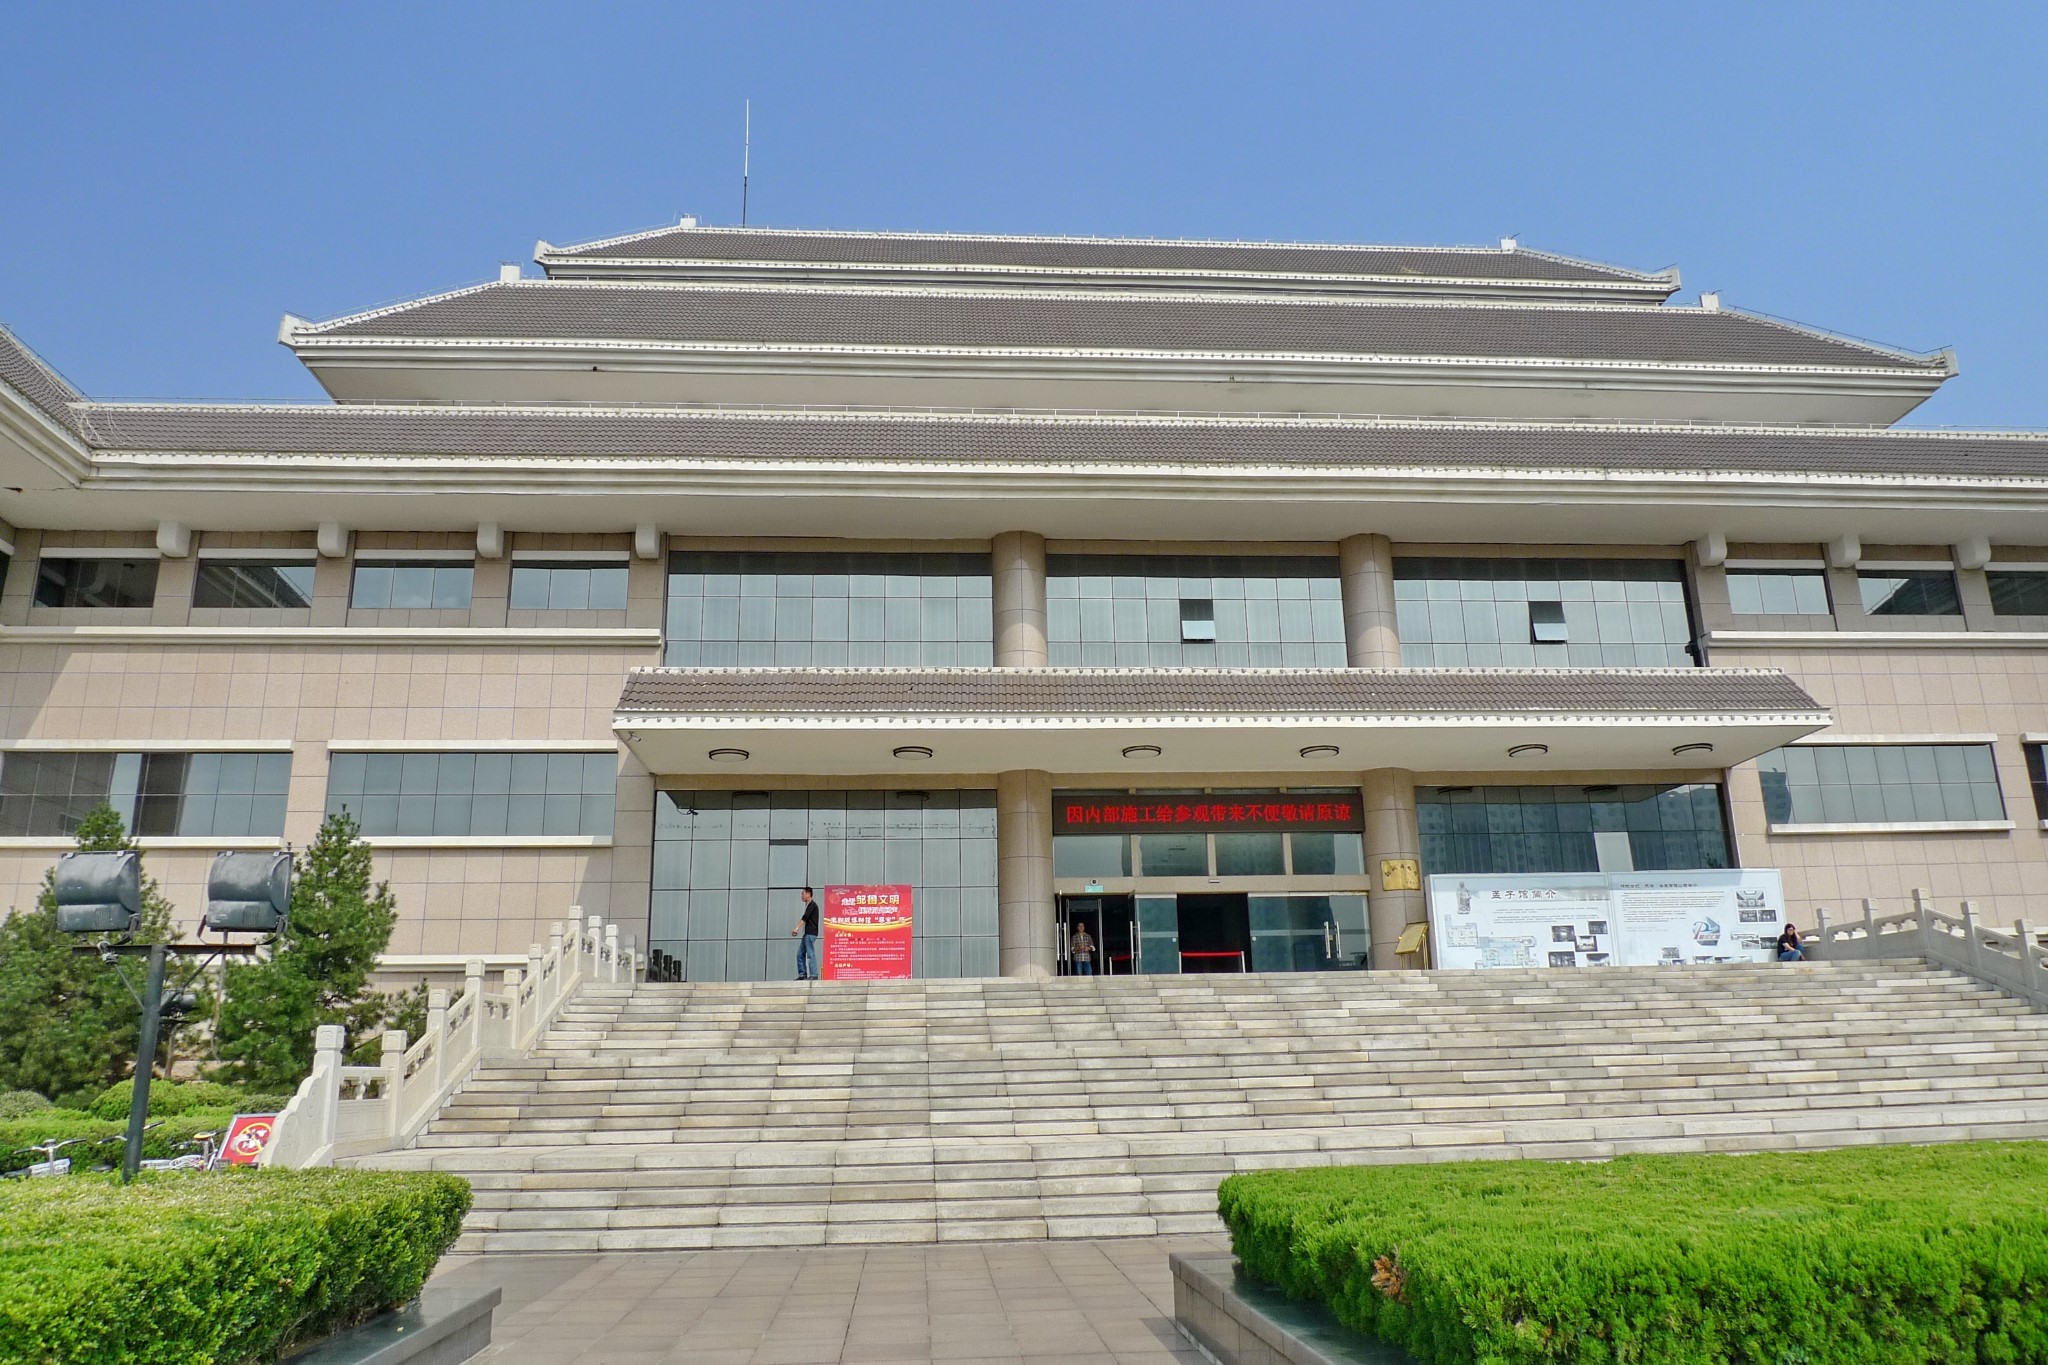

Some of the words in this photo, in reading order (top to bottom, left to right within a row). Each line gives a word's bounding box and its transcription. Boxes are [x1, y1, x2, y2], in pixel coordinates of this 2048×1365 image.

[1066, 803, 1351, 824] 因内部施工给参观带来不便敬请原谅
[1491, 889, 1556, 899] 孟子馆简介
